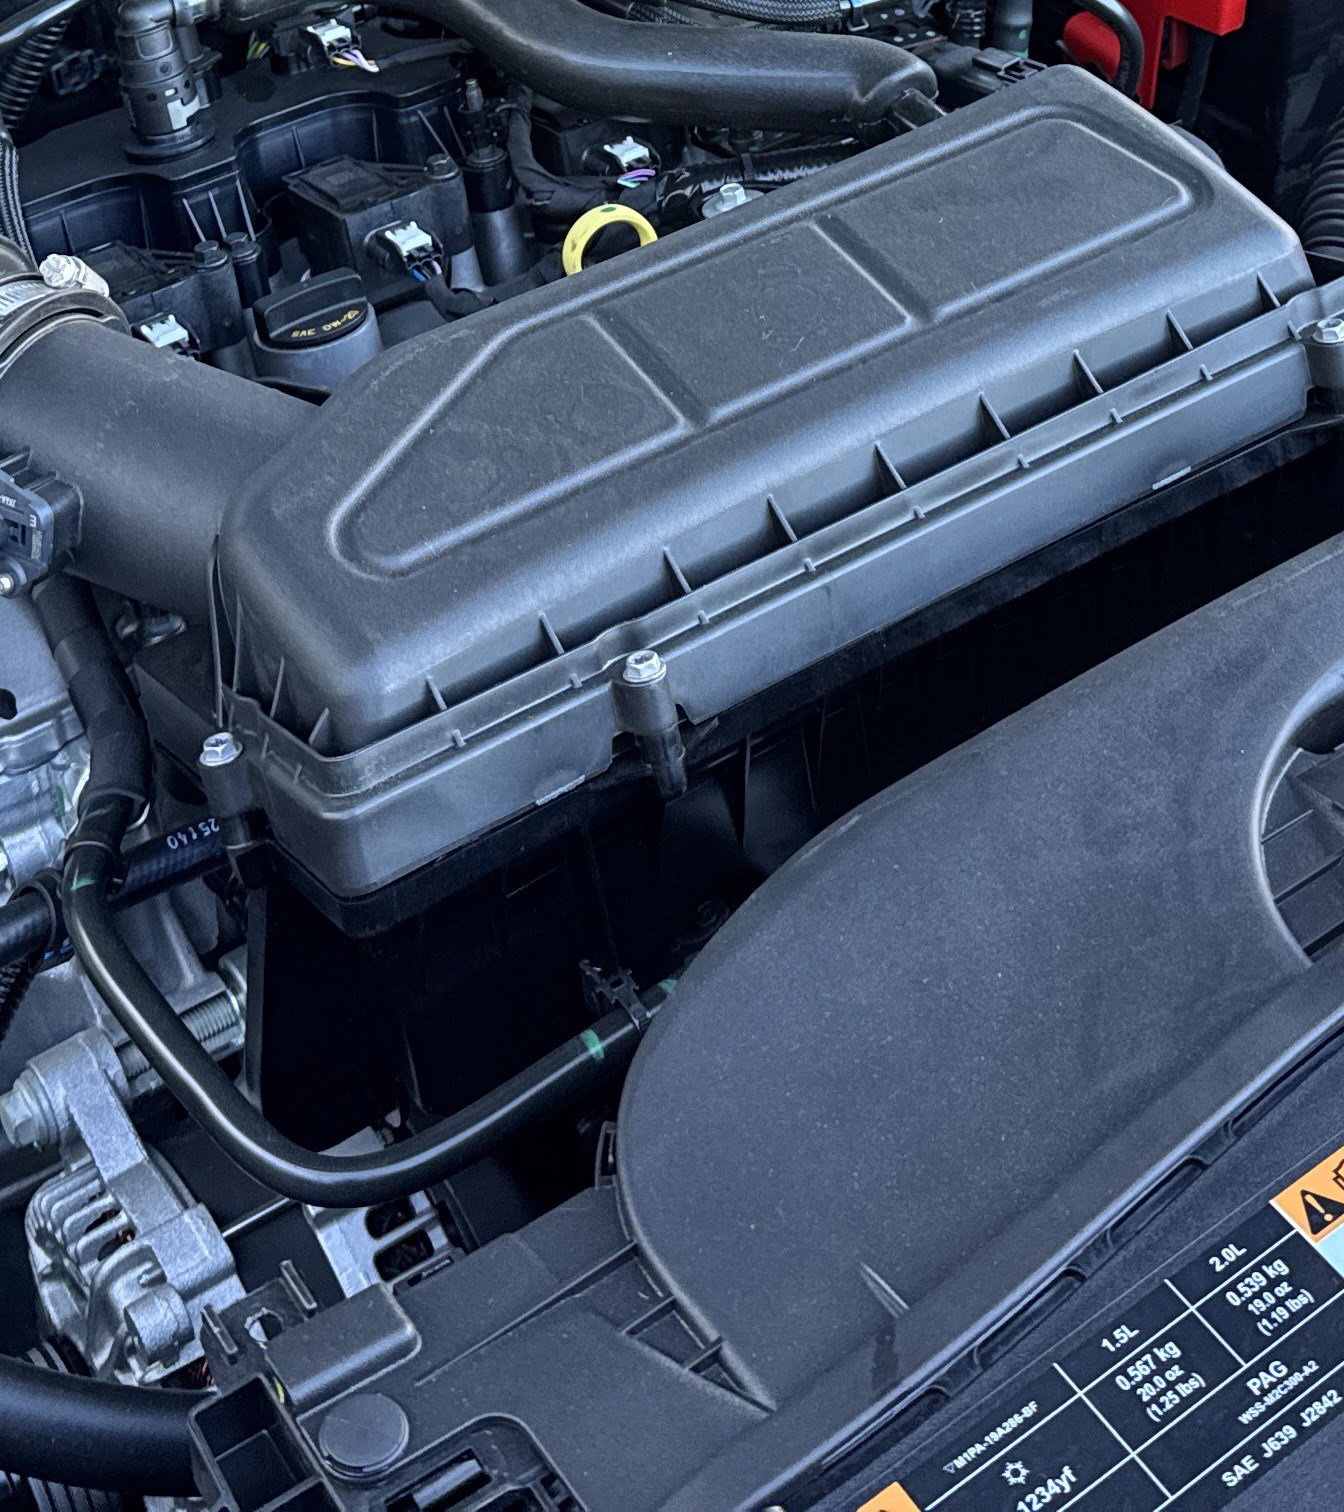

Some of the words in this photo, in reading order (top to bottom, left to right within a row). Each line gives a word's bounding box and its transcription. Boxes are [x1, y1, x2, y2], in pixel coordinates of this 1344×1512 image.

[1208, 1243, 1248, 1273] 2.0L
[1225, 1271, 1268, 1306] 0.539
[1261, 1258, 1290, 1279] kg
[1247, 1291, 1277, 1316] 19.0
[1273, 1281, 1294, 1298] oz
[1256, 1306, 1290, 1337] (1.19
[1284, 1288, 1315, 1313] lbs)
[1101, 1324, 1140, 1352] 1.5L
[1114, 1353, 1157, 1391] 0.567
[1152, 1341, 1182, 1362] kg
[1135, 1375, 1167, 1403] 20.0
[1164, 1364, 1185, 1382] oz
[1246, 1360, 1288, 1396] PAG
[1145, 1390, 1181, 1423] (1.25
[1174, 1372, 1206, 1398] lbs)
[1221, 1454, 1260, 1487] SAE
[1261, 1424, 1298, 1458] J639
[1299, 1389, 1343, 1427] J2842
